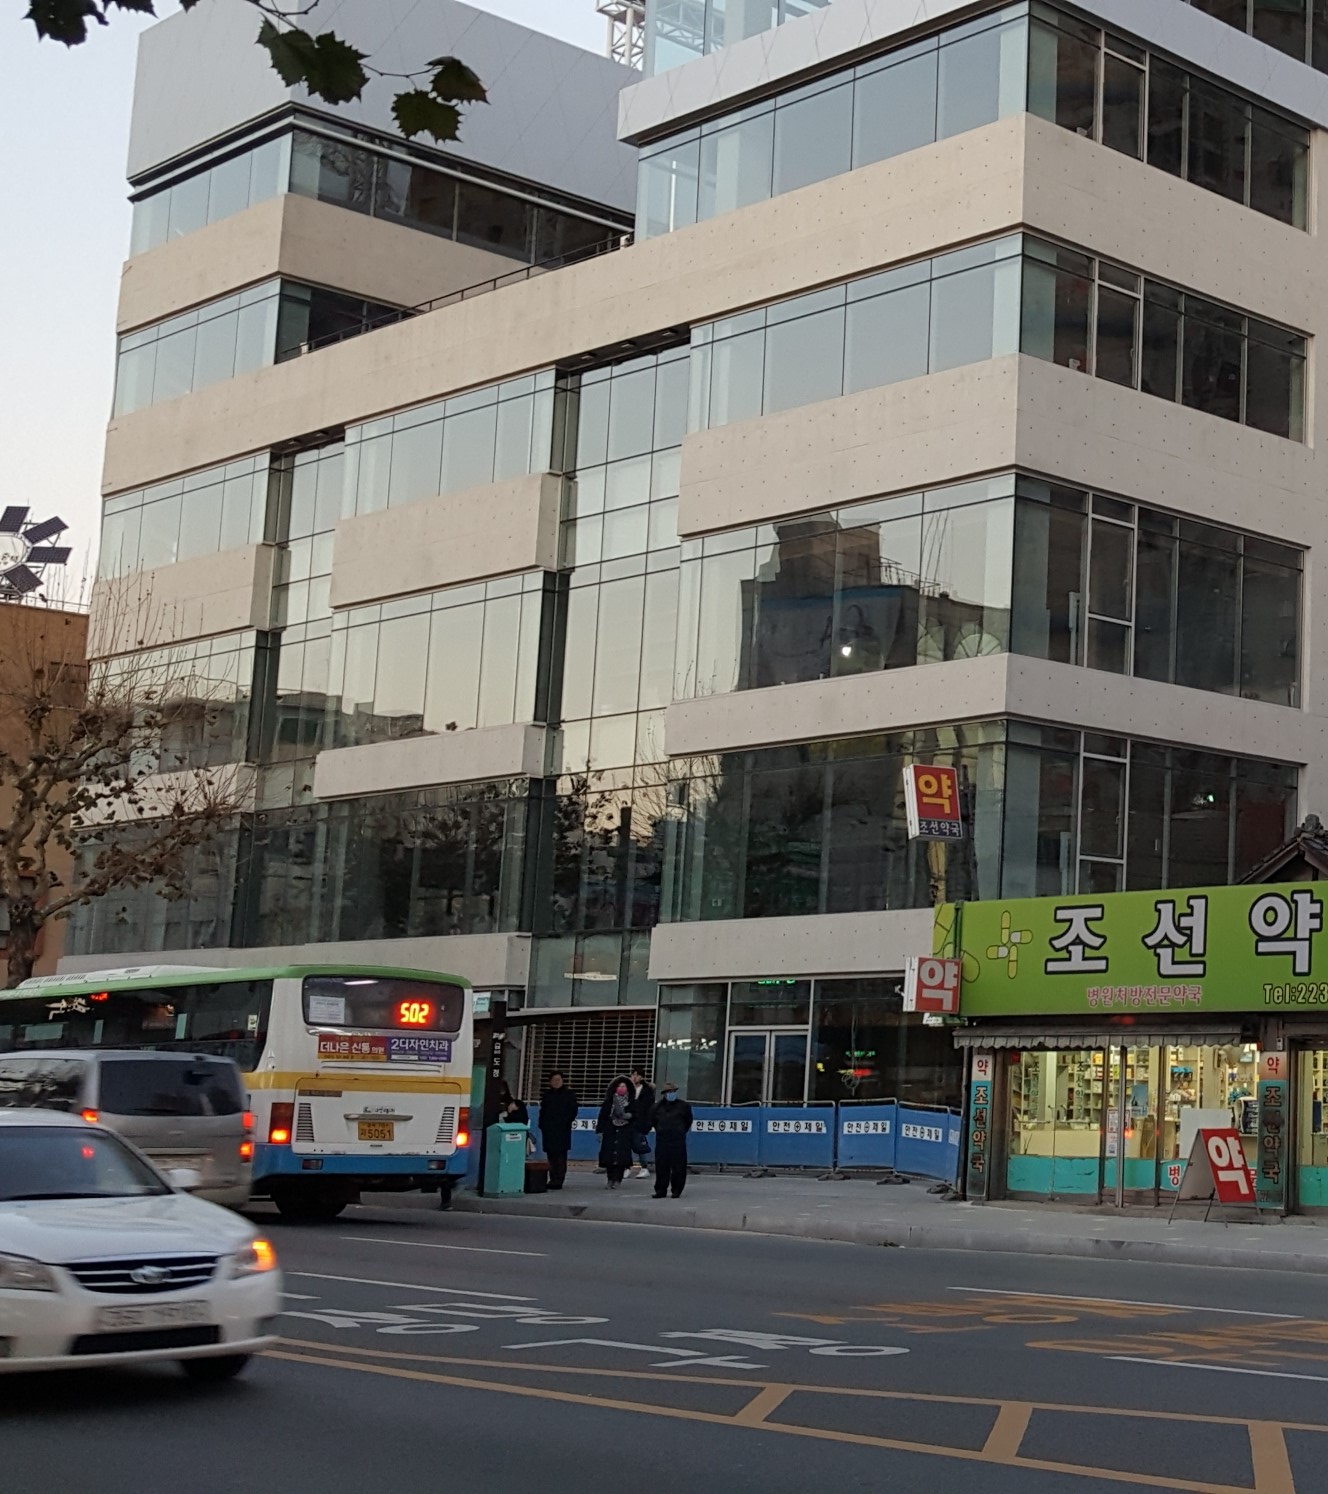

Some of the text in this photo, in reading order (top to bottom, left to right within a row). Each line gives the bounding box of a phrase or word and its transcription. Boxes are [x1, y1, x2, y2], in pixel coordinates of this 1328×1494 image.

[917, 773, 953, 815] 약
[919, 819, 961, 838] 조선약국
[919, 958, 960, 1012] 약
[1086, 984, 1203, 1008] 병원처방전문약국
[399, 1001, 431, 1025] 502
[319, 1041, 350, 1053] 더나은
[977, 1059, 989, 1076] 약
[1267, 1056, 1280, 1075] 약
[695, 1119, 750, 1132] 안전 제일
[771, 1120, 824, 1133] 안전 제일
[971, 1085, 989, 1174] 조선약국
[1206, 1135, 1251, 1196] 약
